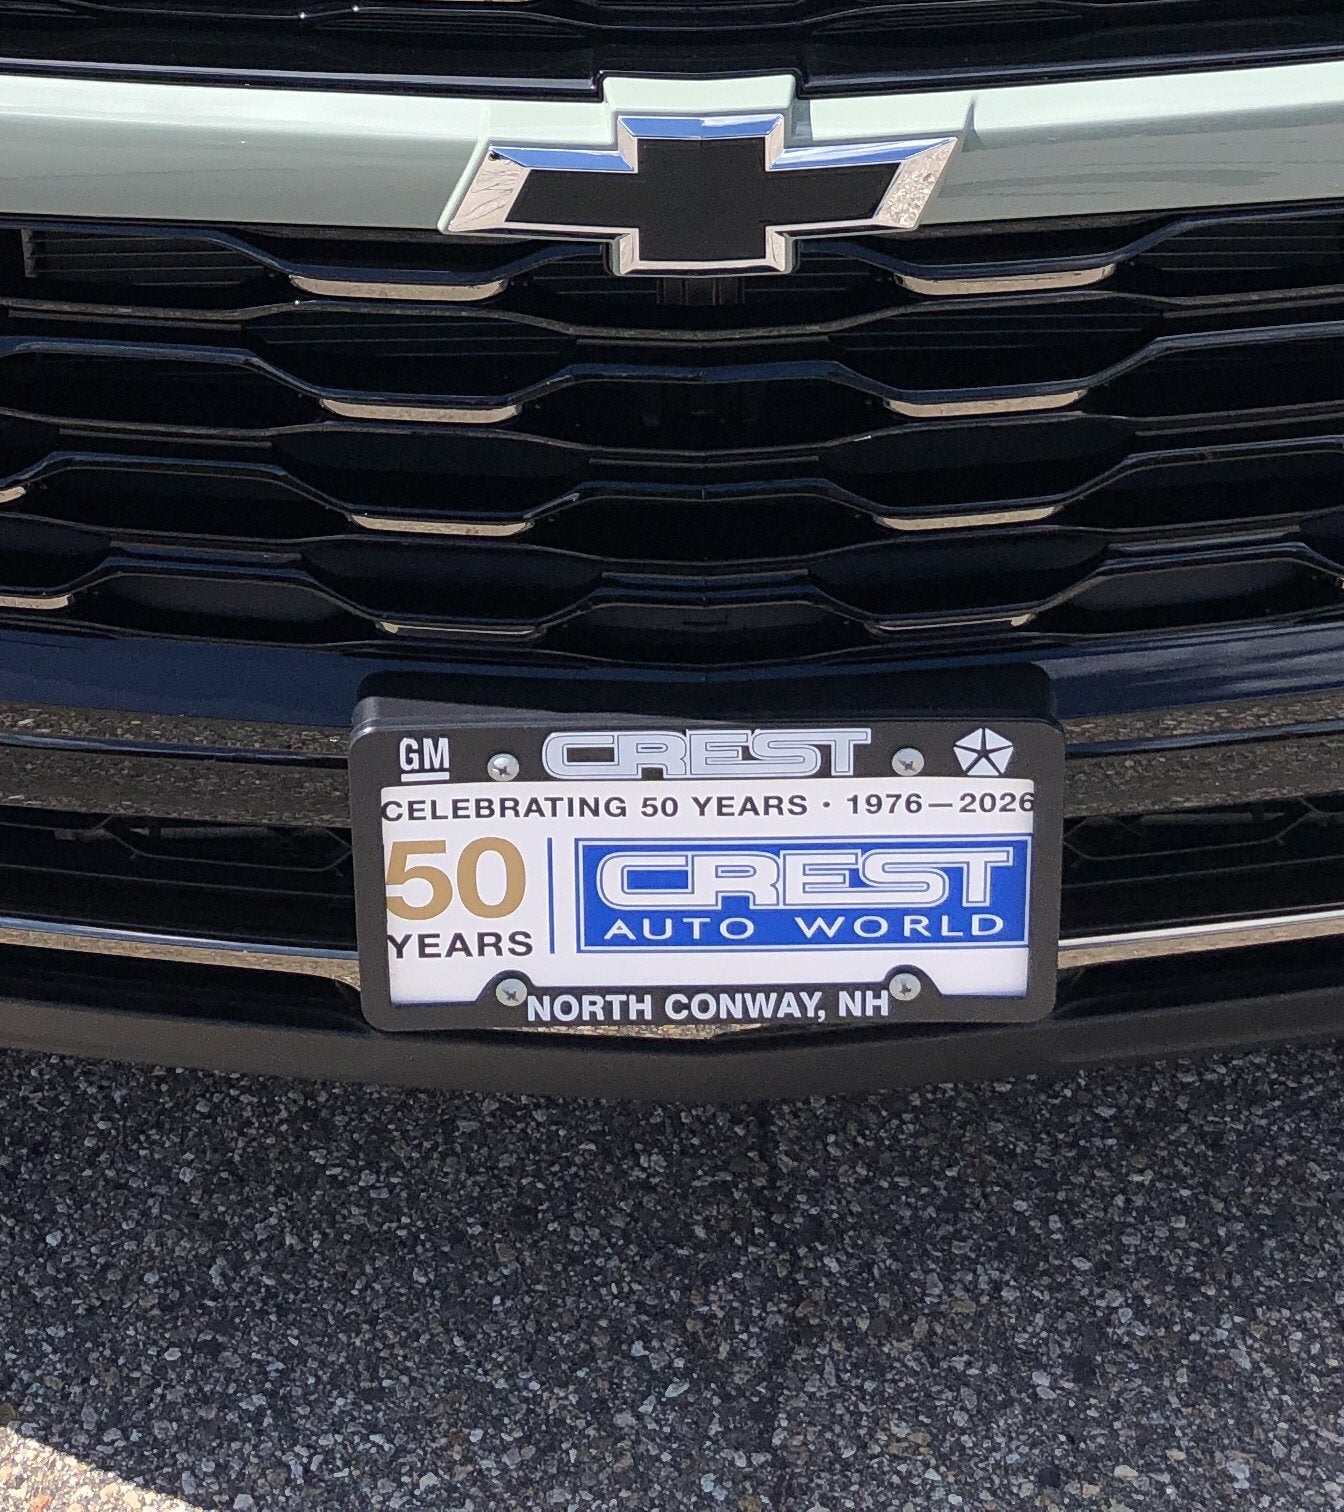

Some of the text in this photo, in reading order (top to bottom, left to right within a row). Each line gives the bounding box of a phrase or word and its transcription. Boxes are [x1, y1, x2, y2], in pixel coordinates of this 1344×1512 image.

[399, 737, 450, 771] GM
[542, 728, 871, 780] CREST
[381, 796, 627, 822] CELEBRATING
[640, 796, 679, 818] 50
[691, 794, 808, 817] YEARS
[385, 836, 527, 921] 50
[596, 846, 1014, 911] CREST
[603, 913, 1004, 940] AUTO WORLD
[387, 930, 534, 959] YEARS
[527, 989, 890, 1023] NORTH CONWAY, NH
